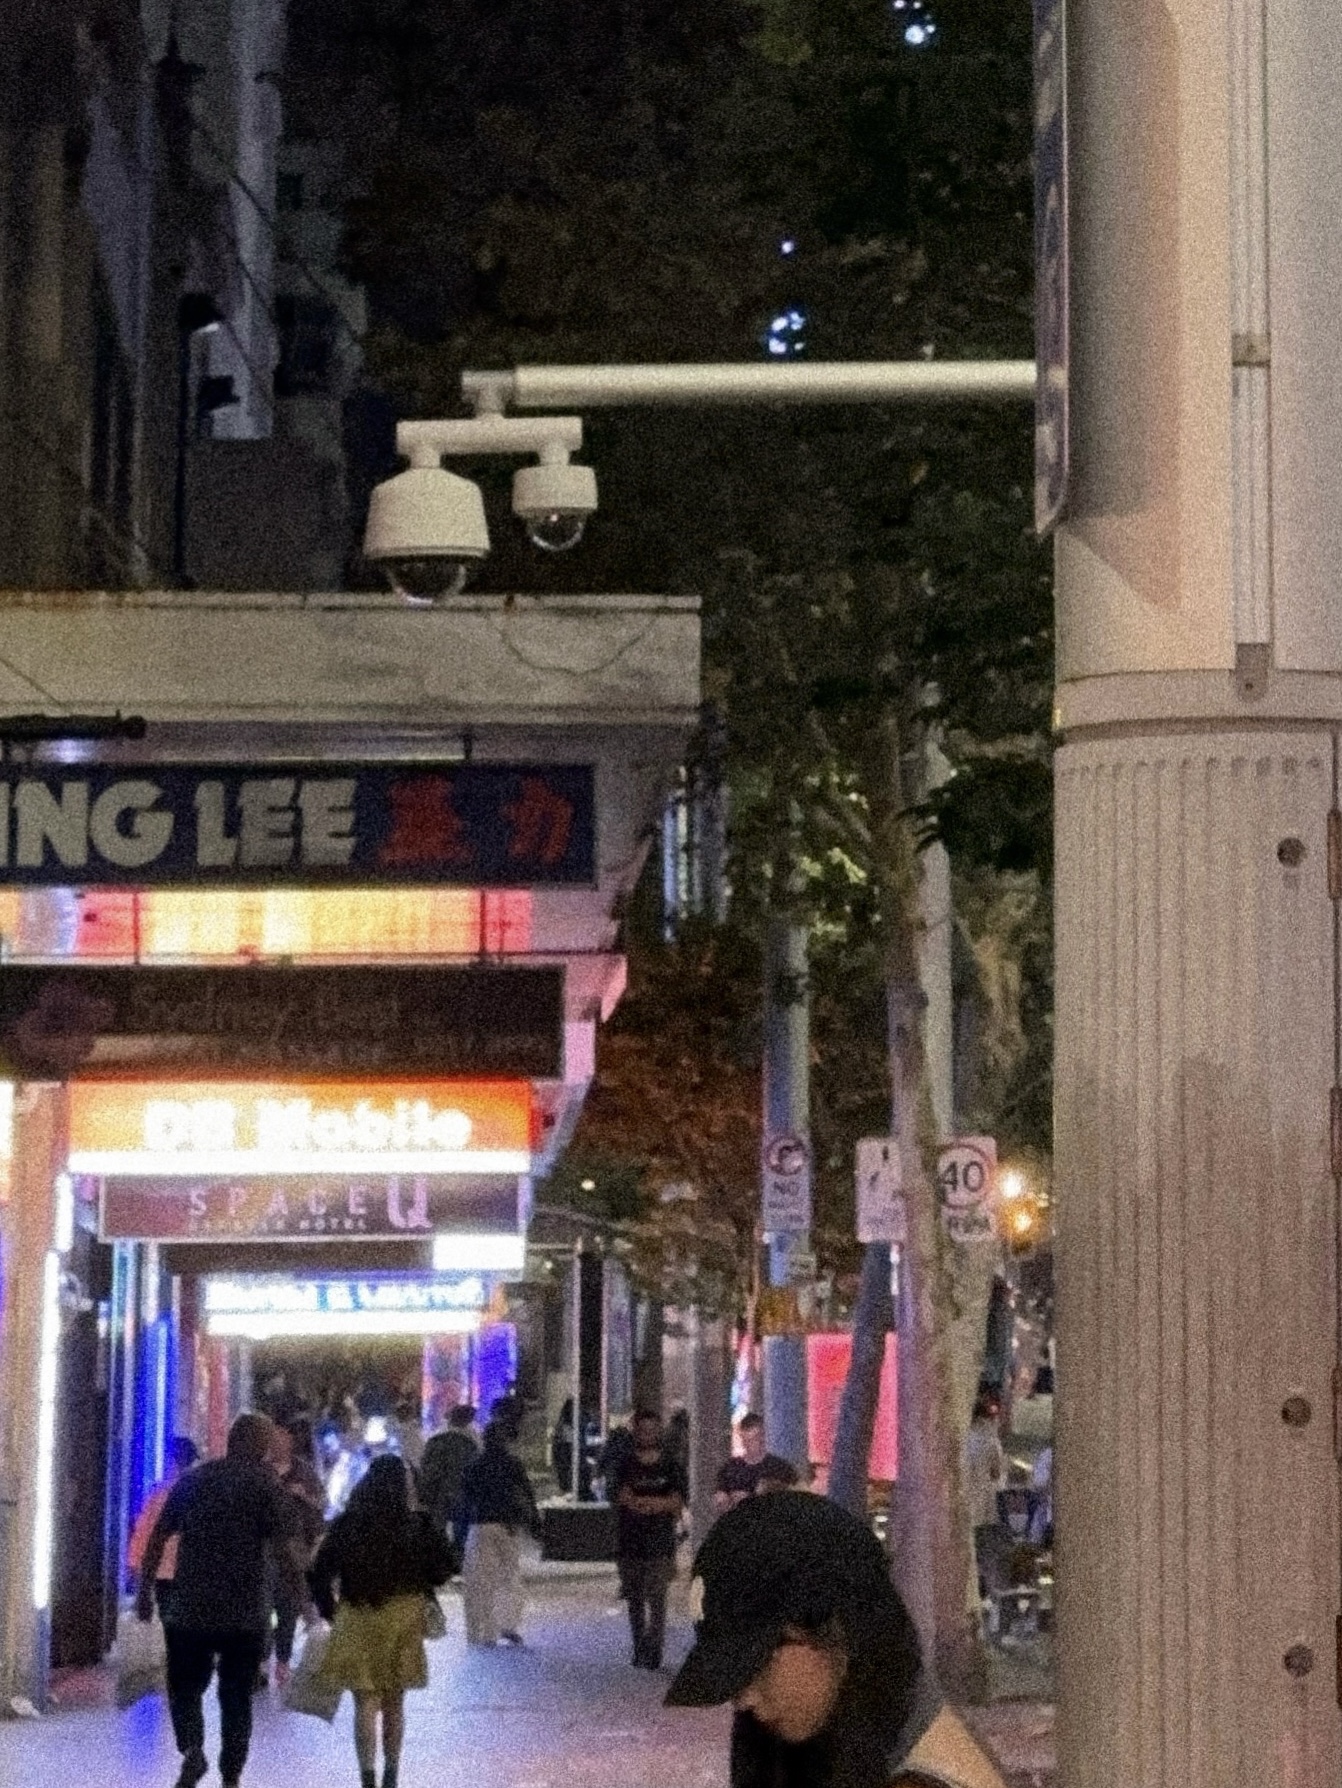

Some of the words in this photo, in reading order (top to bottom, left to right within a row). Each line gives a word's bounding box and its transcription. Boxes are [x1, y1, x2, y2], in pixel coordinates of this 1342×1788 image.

[194, 776, 358, 868] LEE
[941, 1159, 985, 1194] 40
[189, 1185, 367, 1217] SPACE
